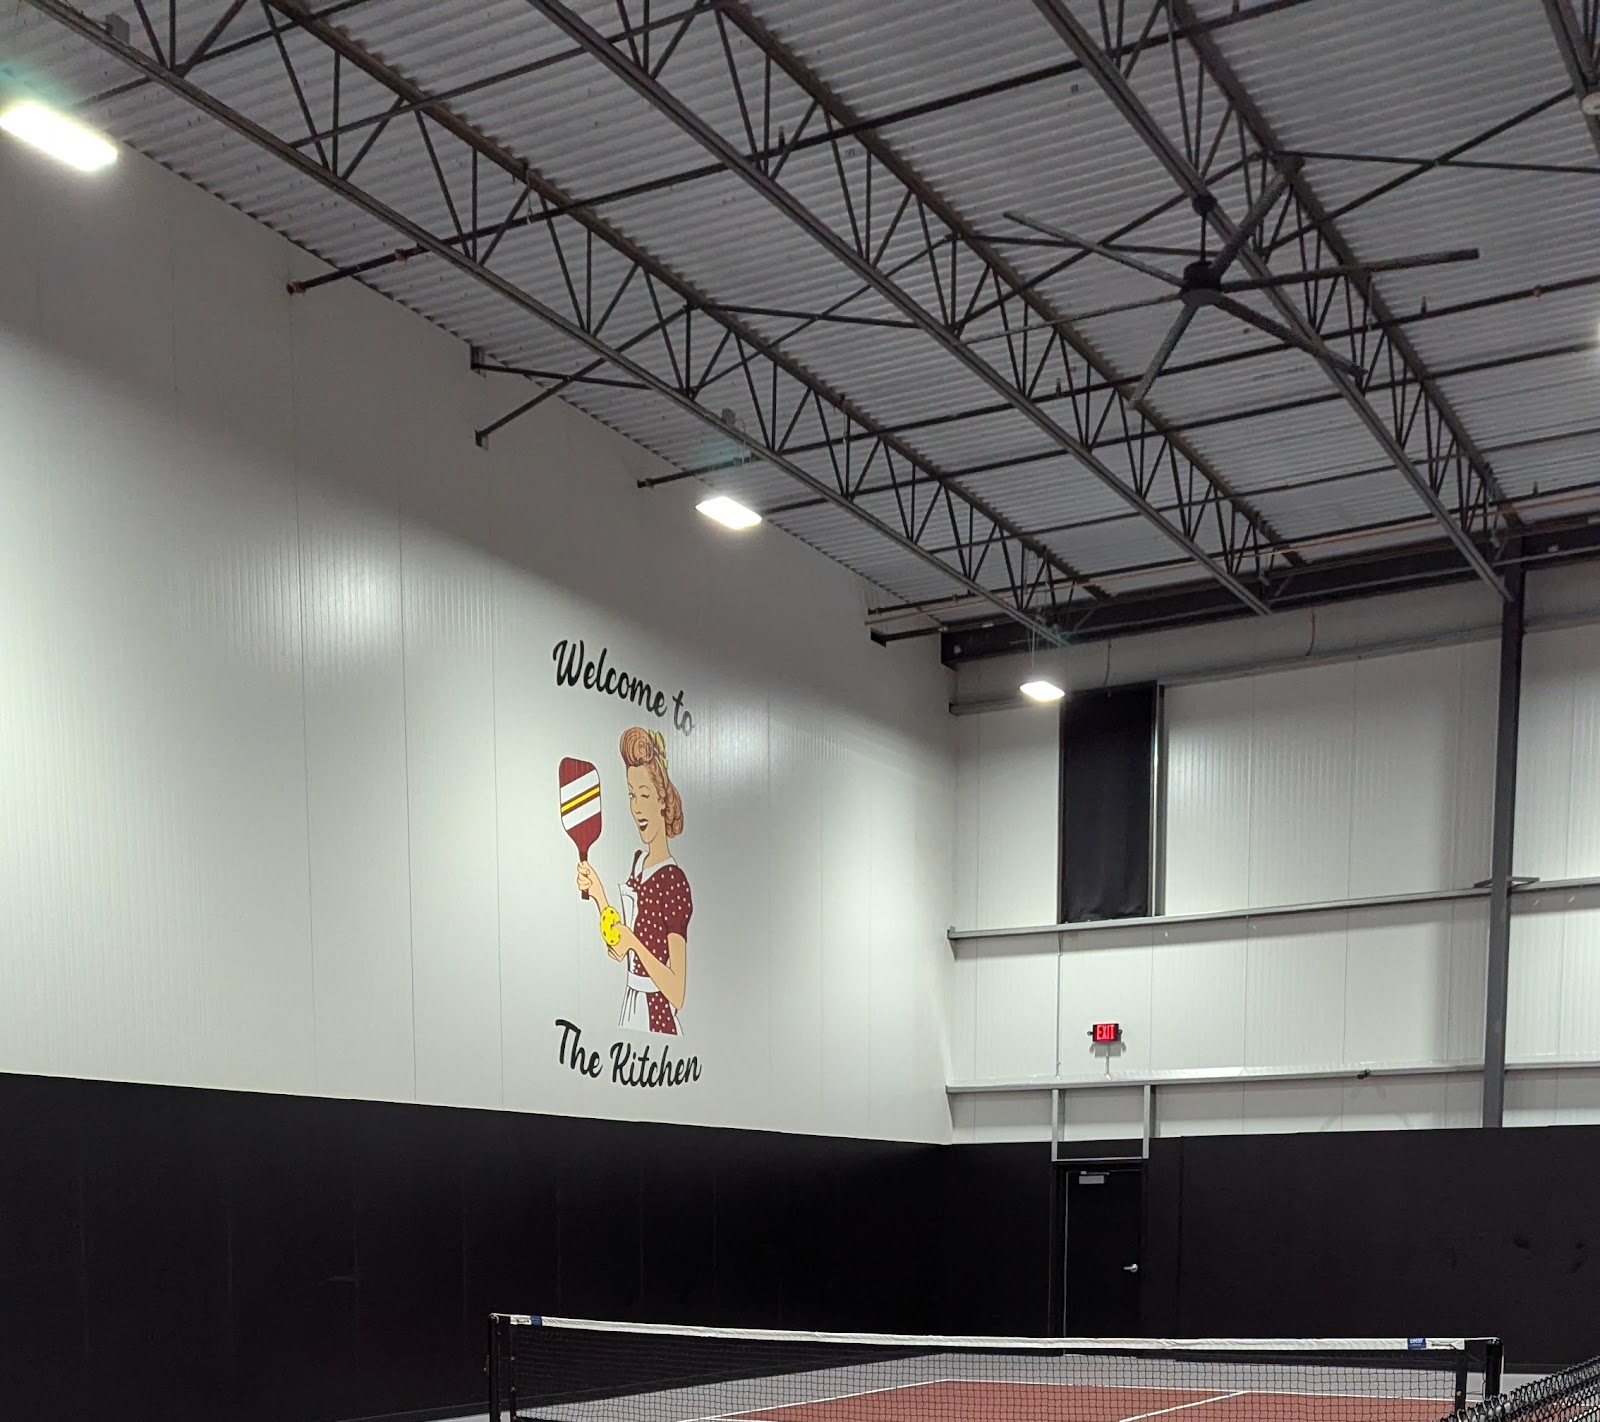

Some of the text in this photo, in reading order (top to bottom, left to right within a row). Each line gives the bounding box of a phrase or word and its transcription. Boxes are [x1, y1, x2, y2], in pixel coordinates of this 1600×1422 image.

[552, 639, 695, 737] Welcome to
[555, 1019, 702, 1088] The Kitchen
[1096, 1024, 1115, 1040] EXIT
